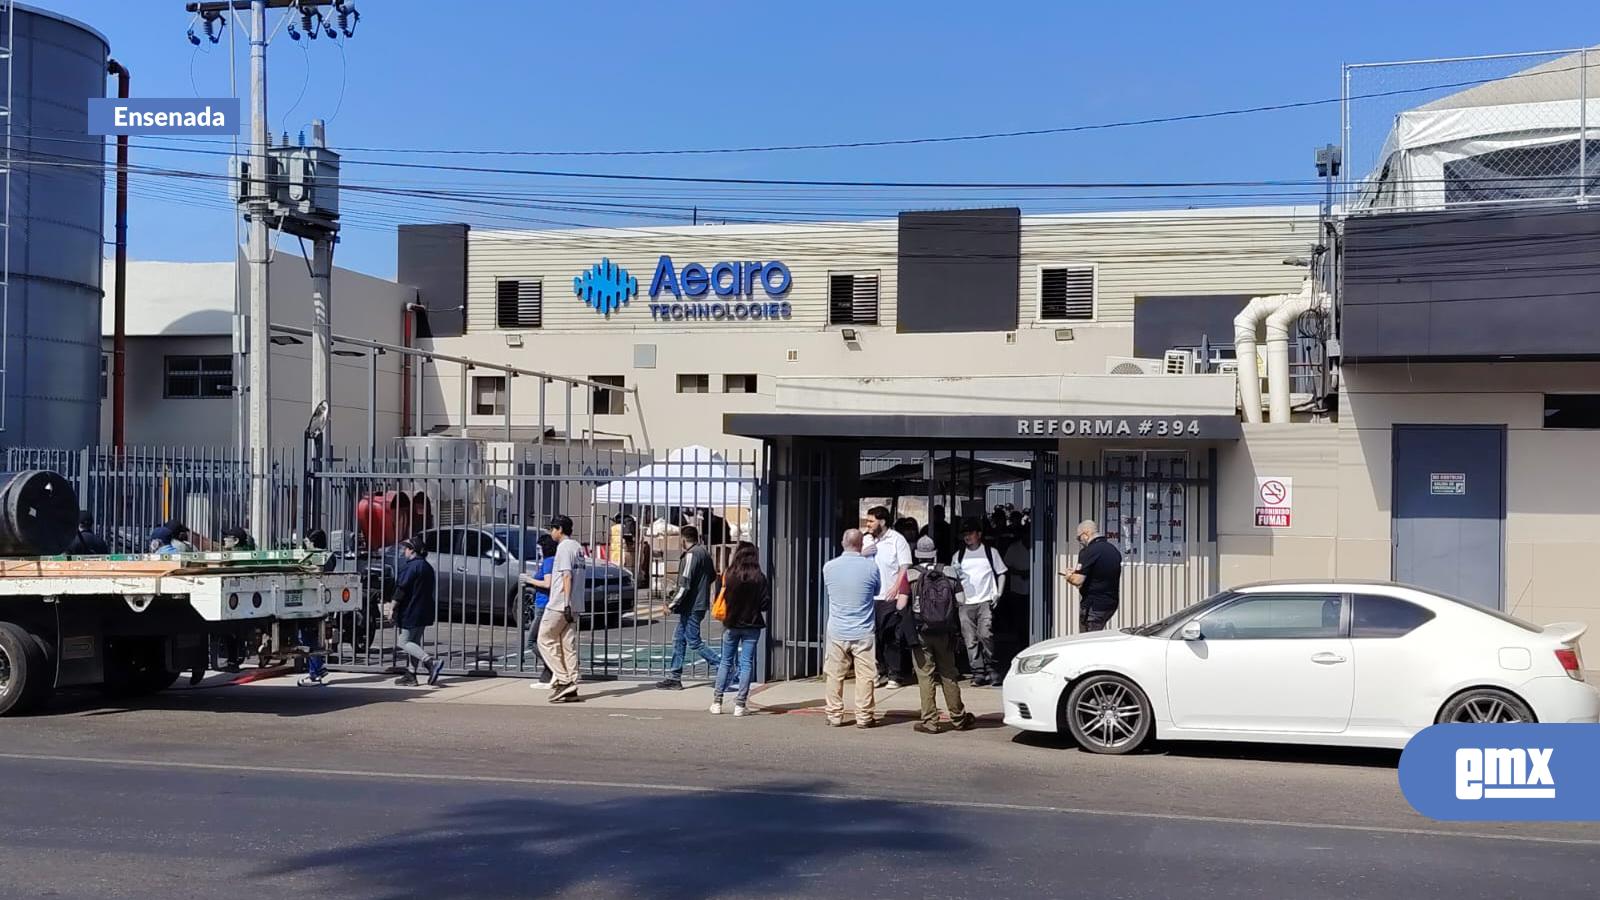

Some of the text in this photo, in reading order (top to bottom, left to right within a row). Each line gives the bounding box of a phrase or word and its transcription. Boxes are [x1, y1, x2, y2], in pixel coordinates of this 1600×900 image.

[649, 254, 792, 300] Aearo
[649, 302, 792, 321] TECHNOLOGIES
[1017, 419, 1200, 435] REFORMA #394
[1258, 515, 1288, 526] FUMAR
